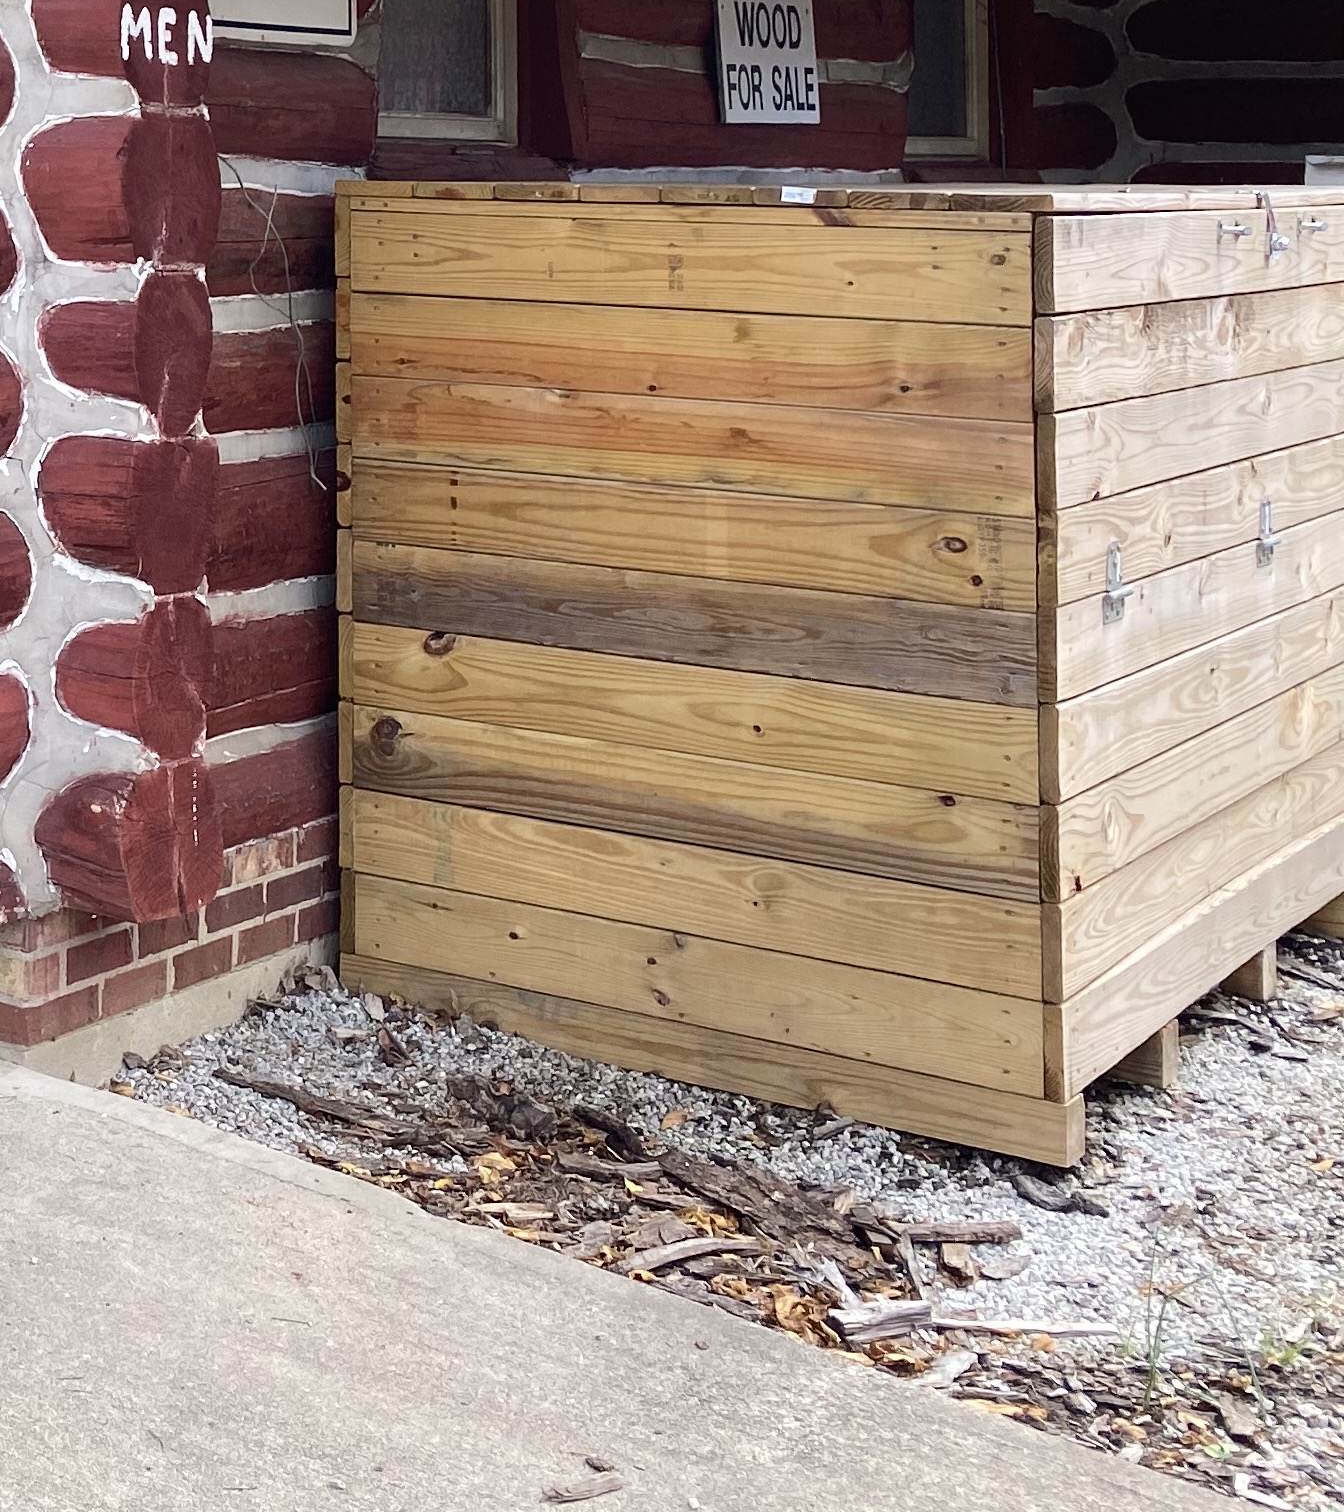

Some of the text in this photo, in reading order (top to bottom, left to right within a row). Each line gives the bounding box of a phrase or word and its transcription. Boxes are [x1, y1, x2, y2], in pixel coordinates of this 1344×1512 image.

[120, 2, 214, 66] MEN
[734, 0, 802, 49] WOOD
[726, 63, 817, 111] FOR SALE
